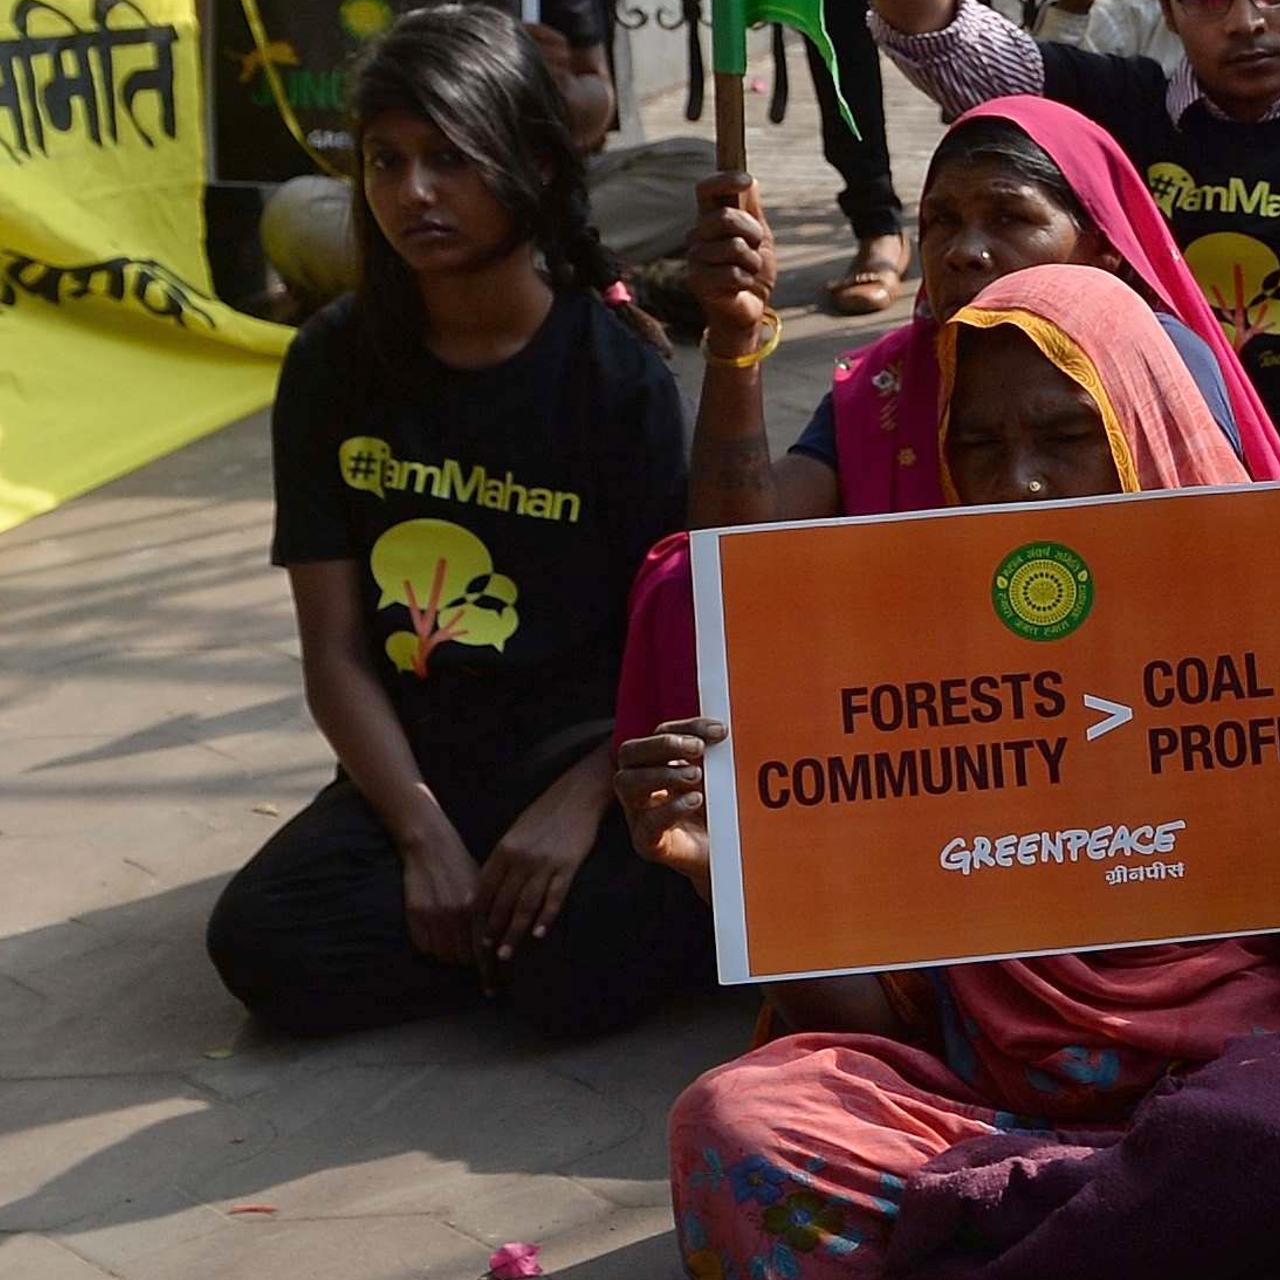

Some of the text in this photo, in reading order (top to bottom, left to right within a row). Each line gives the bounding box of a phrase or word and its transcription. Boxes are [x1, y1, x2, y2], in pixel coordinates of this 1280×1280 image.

[841, 669, 1067, 734] FORESTS
[1142, 651, 1274, 708] COAL
[757, 736, 1069, 811] COMMUNITY
[939, 819, 1187, 877] GREENPEACE
[1105, 861, 1185, 885] ग्रीनपीस
